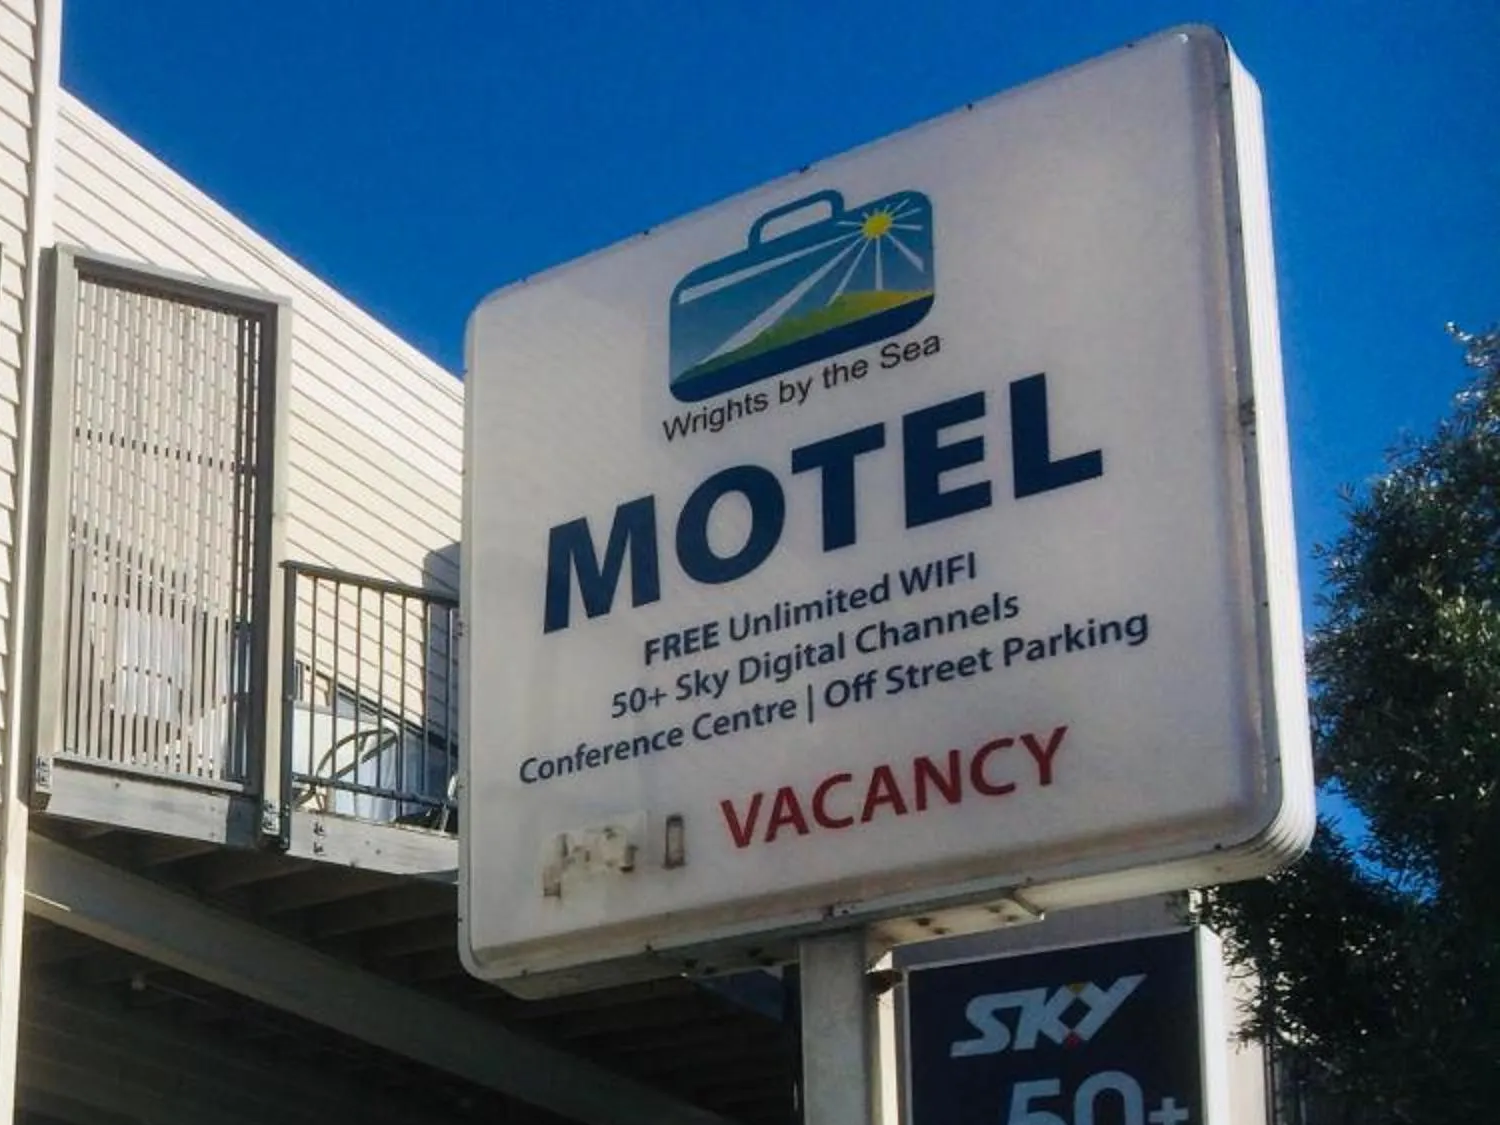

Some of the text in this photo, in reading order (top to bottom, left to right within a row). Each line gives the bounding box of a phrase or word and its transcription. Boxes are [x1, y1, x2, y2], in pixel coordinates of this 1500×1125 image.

[662, 334, 942, 442] Wrights by the Sea
[544, 373, 1103, 634] MOTEL
[611, 592, 1020, 719] 50+ Sky Digital Channels
[644, 552, 976, 666] FREE Unlimited WIFI
[519, 727, 684, 784] Conference
[692, 698, 797, 741] Centre
[824, 669, 877, 709] Off
[885, 647, 993, 695] Street
[1003, 613, 1149, 667] Parking
[720, 725, 1069, 850] VACANCY
[950, 973, 1148, 1058] SKY
